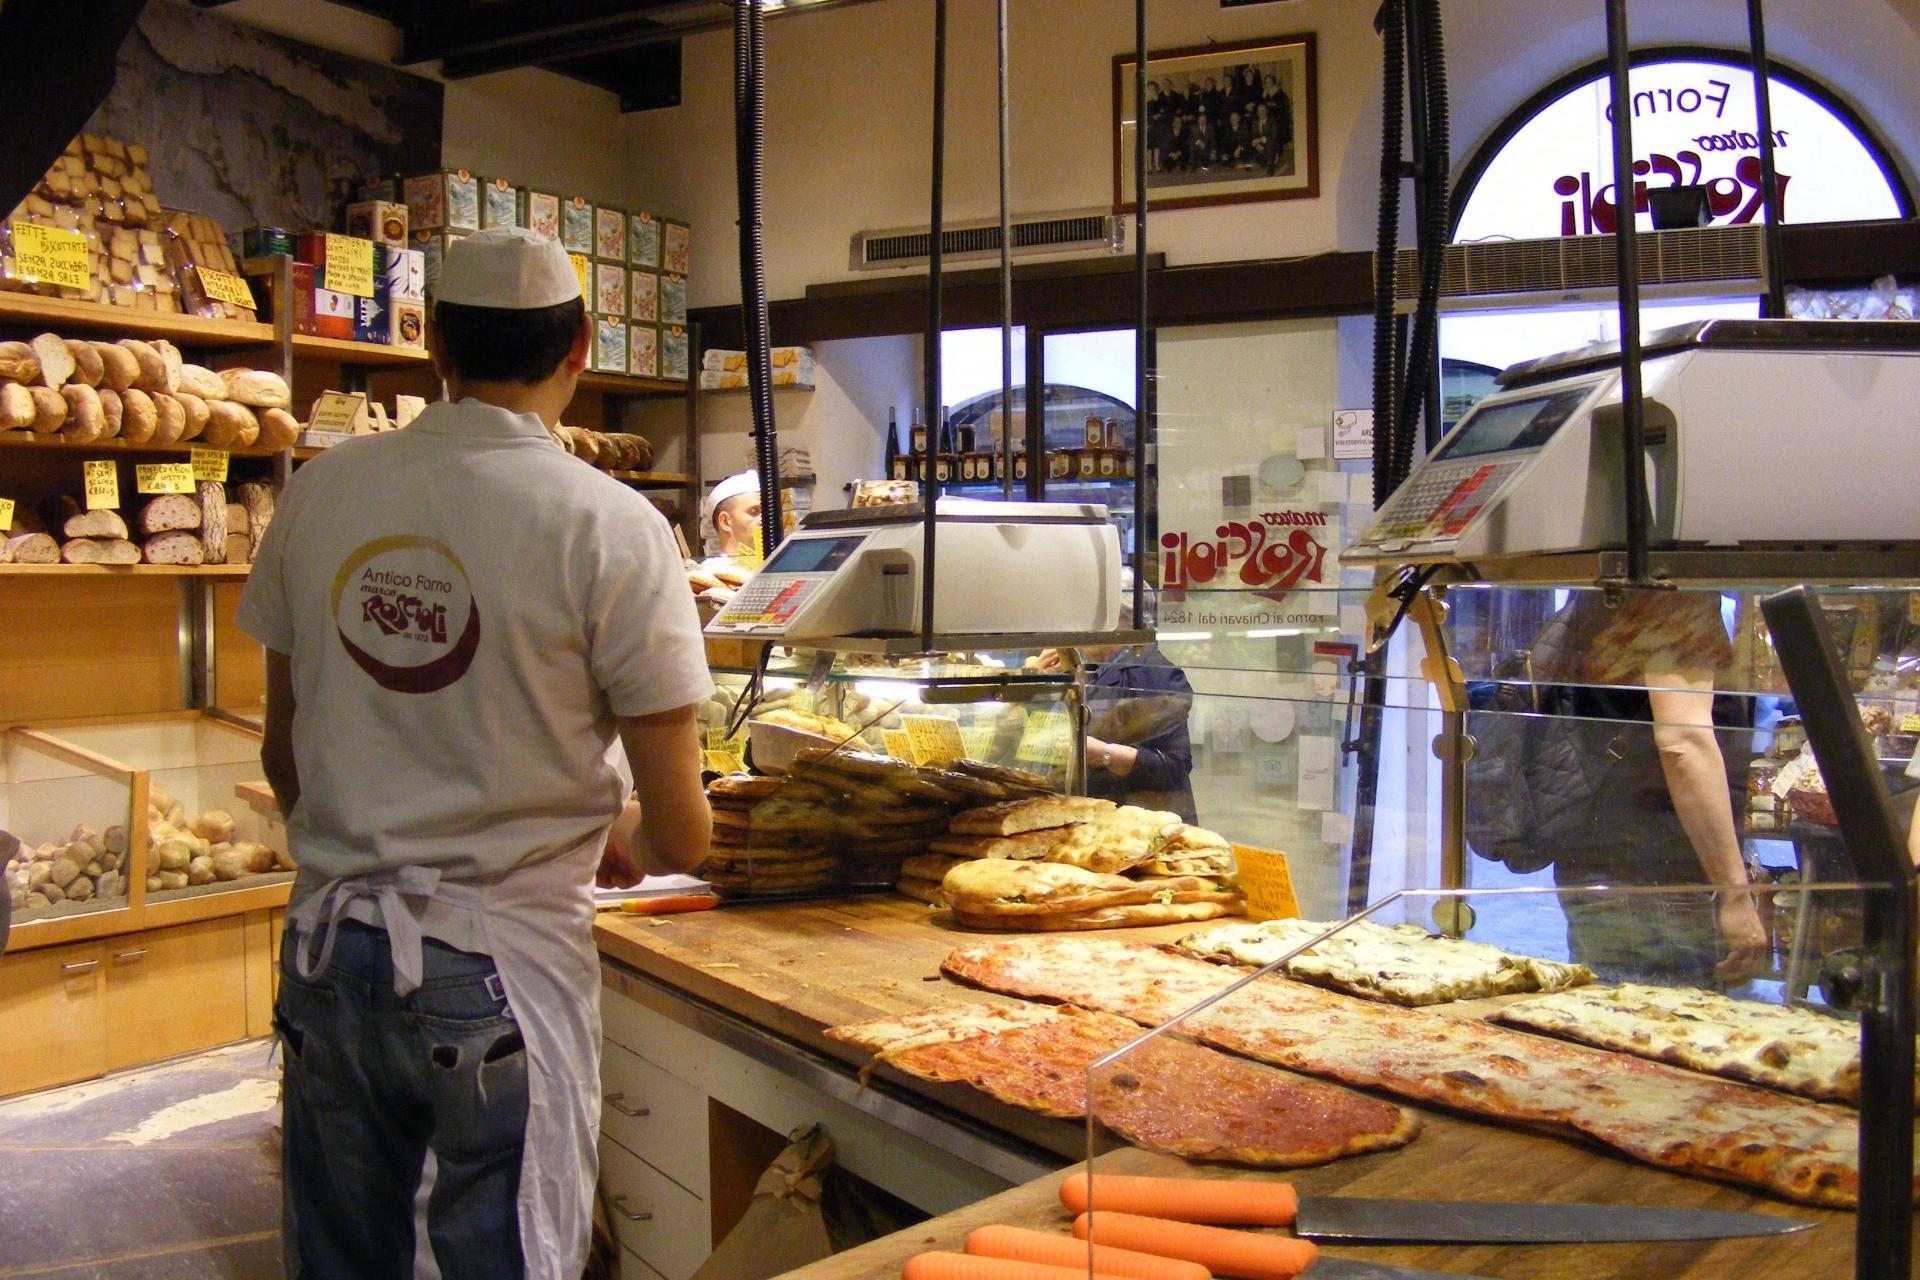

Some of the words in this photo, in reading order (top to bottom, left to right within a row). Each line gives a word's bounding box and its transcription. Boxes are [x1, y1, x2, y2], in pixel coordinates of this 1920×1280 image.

[16, 224, 47, 240] FETTE
[19, 253, 46, 267] SENZA
[26, 266, 54, 281] SENZA
[58, 271, 80, 284] SALE
[1361, 429, 1374, 437] ARE
[362, 567, 412, 588] Antico
[415, 574, 453, 594] Forno
[360, 583, 397, 597] marco
